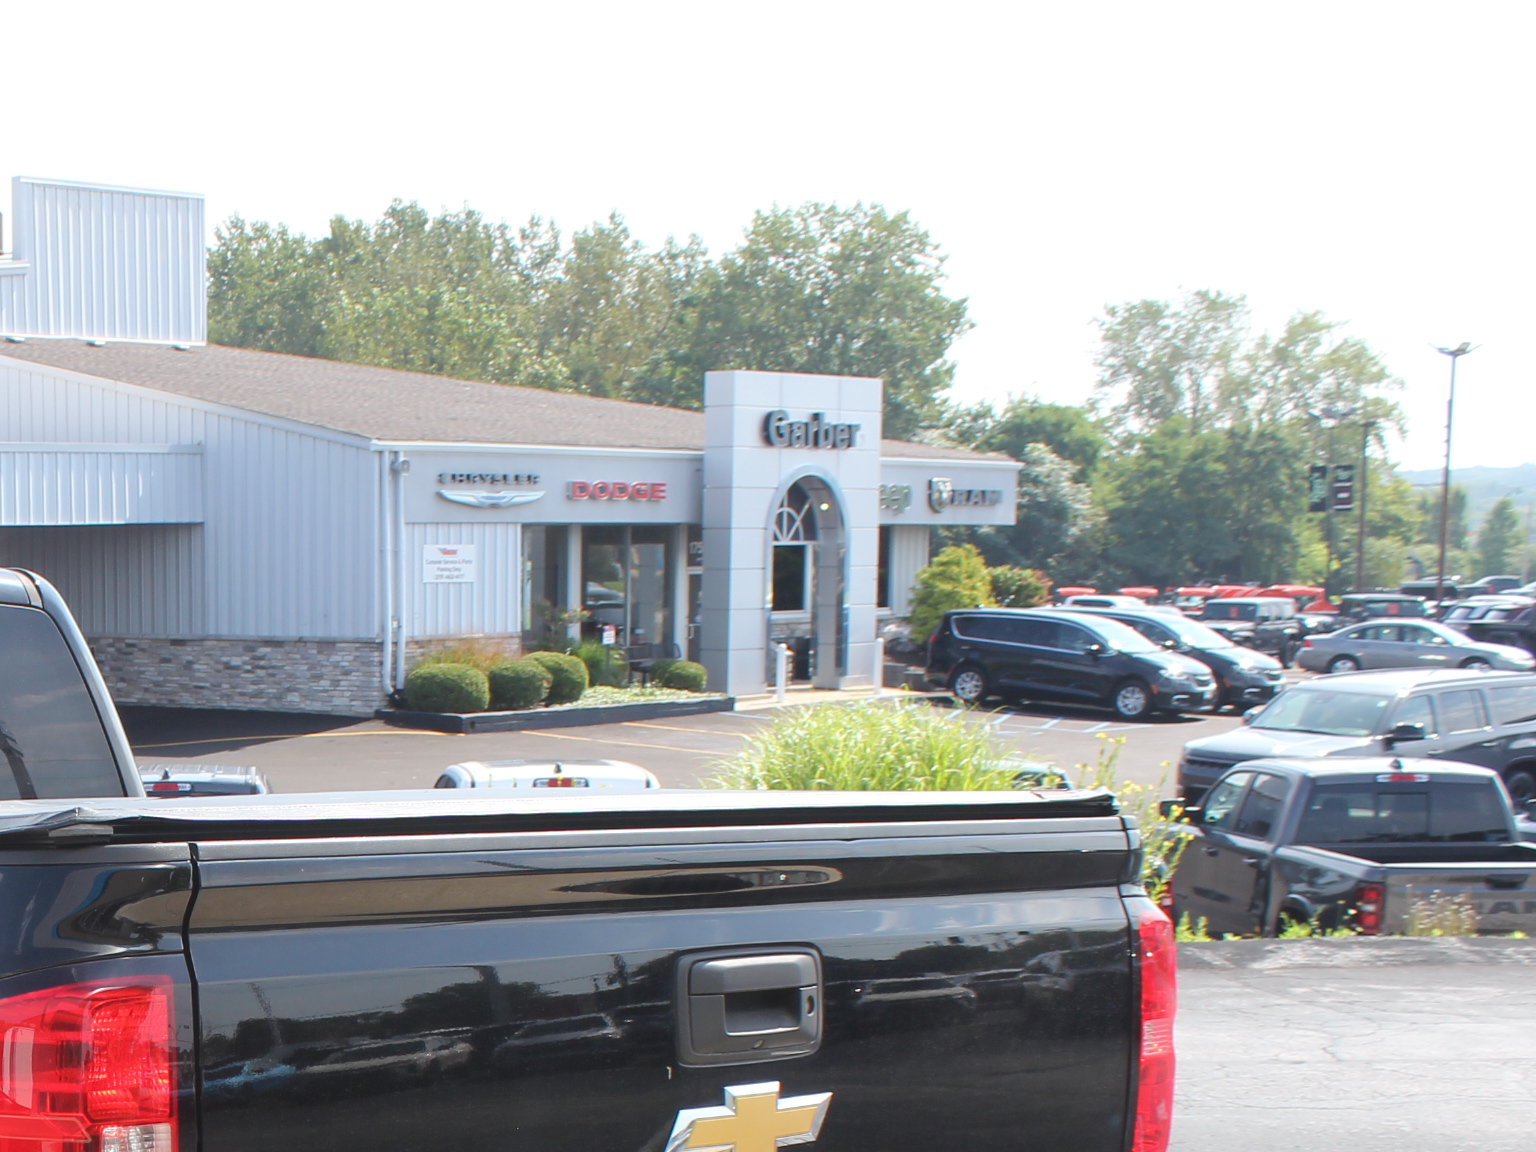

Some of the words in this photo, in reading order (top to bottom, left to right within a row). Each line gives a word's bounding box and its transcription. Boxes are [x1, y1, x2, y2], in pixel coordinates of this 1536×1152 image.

[761, 409, 861, 449] Garber
[567, 480, 667, 501] DODGE
[879, 484, 911, 515] eep
[950, 489, 1004, 506] RAM
